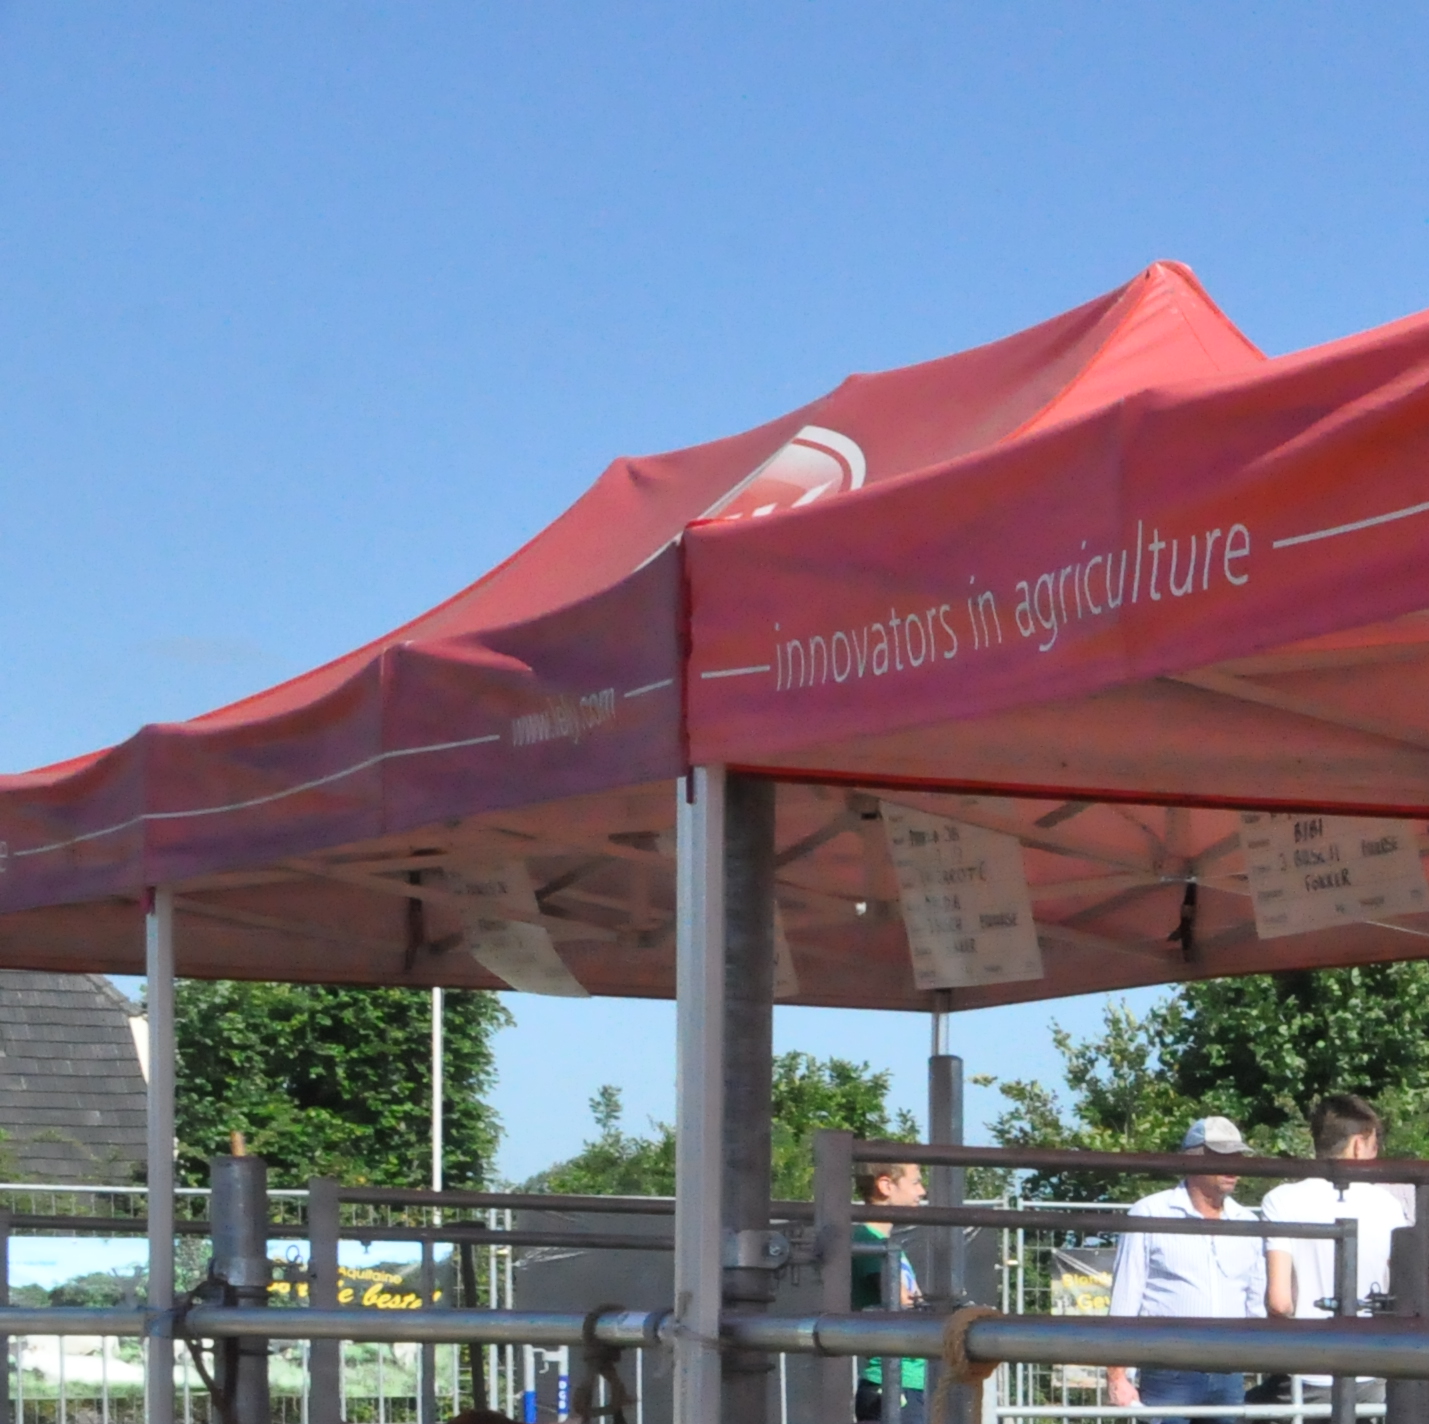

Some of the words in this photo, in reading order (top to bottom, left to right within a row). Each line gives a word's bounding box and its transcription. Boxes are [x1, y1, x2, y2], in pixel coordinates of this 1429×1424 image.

[775, 598, 958, 691] innovators
[968, 575, 1002, 650] in
[1015, 519, 1251, 653] agriculture
